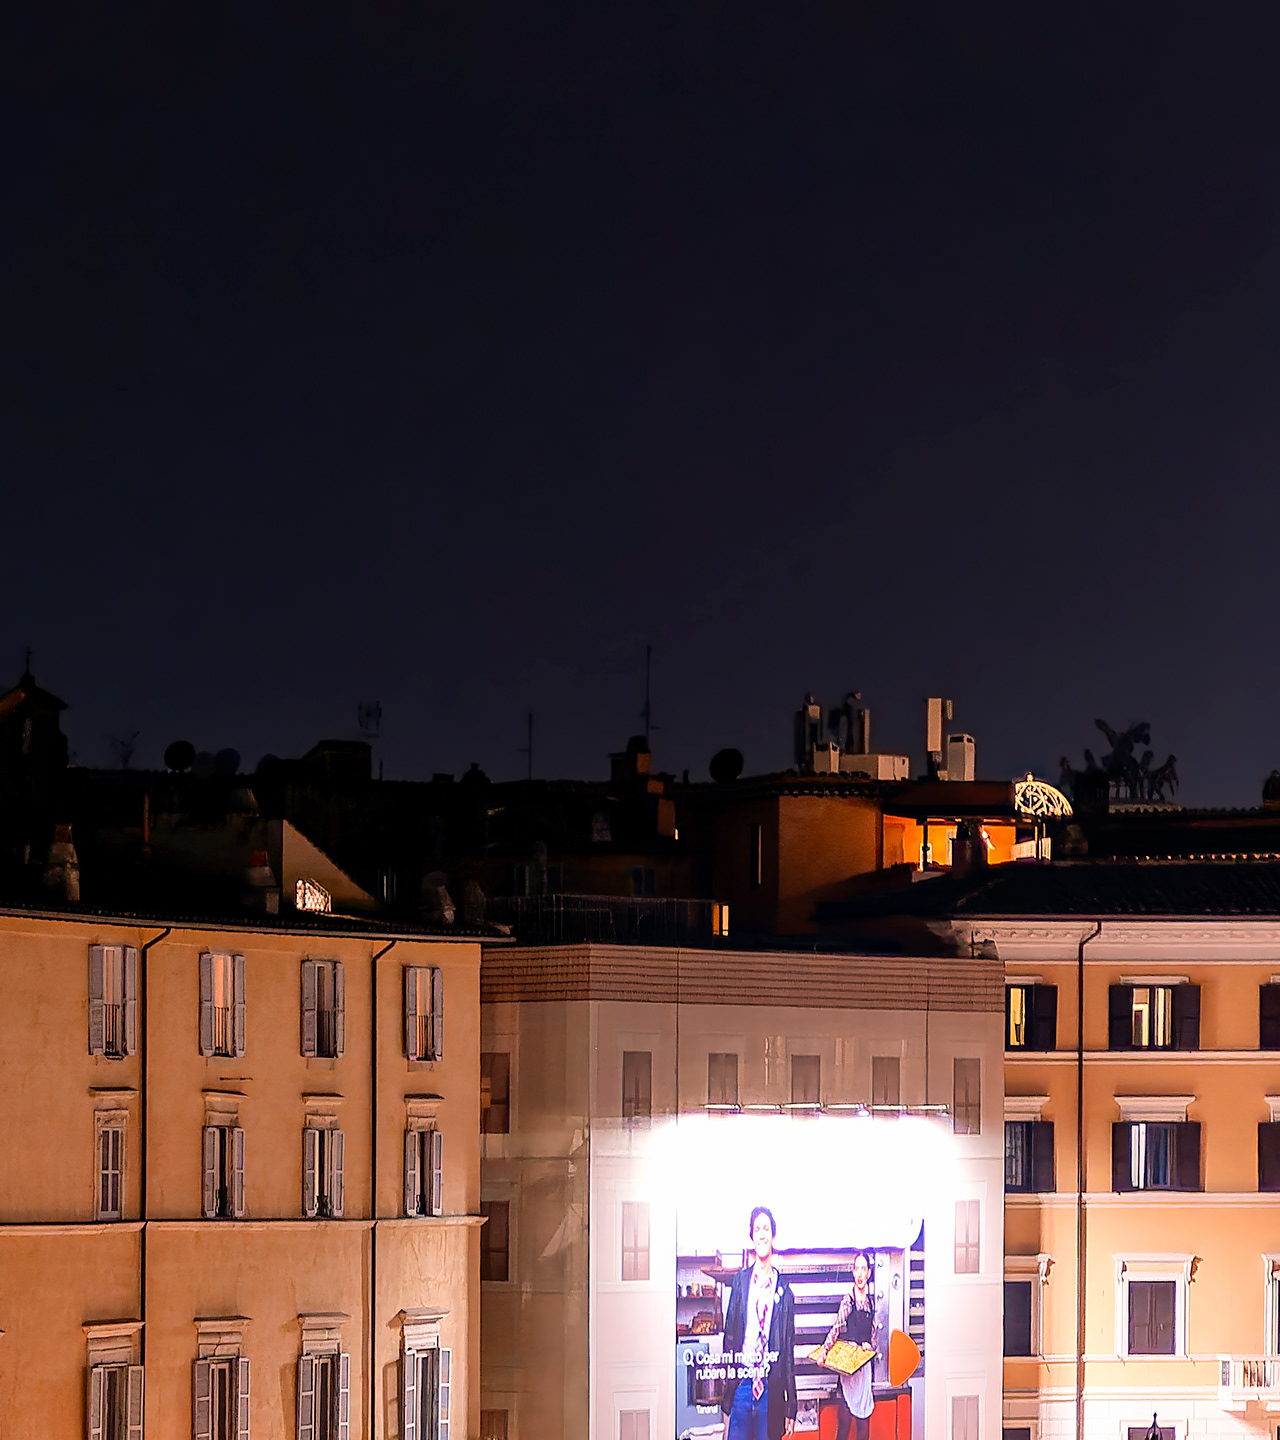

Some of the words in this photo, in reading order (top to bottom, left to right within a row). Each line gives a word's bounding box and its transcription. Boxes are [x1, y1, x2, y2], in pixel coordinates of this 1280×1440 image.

[696, 1350, 721, 1366] Cosa
[763, 1350, 780, 1364] per
[696, 1366, 726, 1380] rubare
[727, 1365, 736, 1379] la
